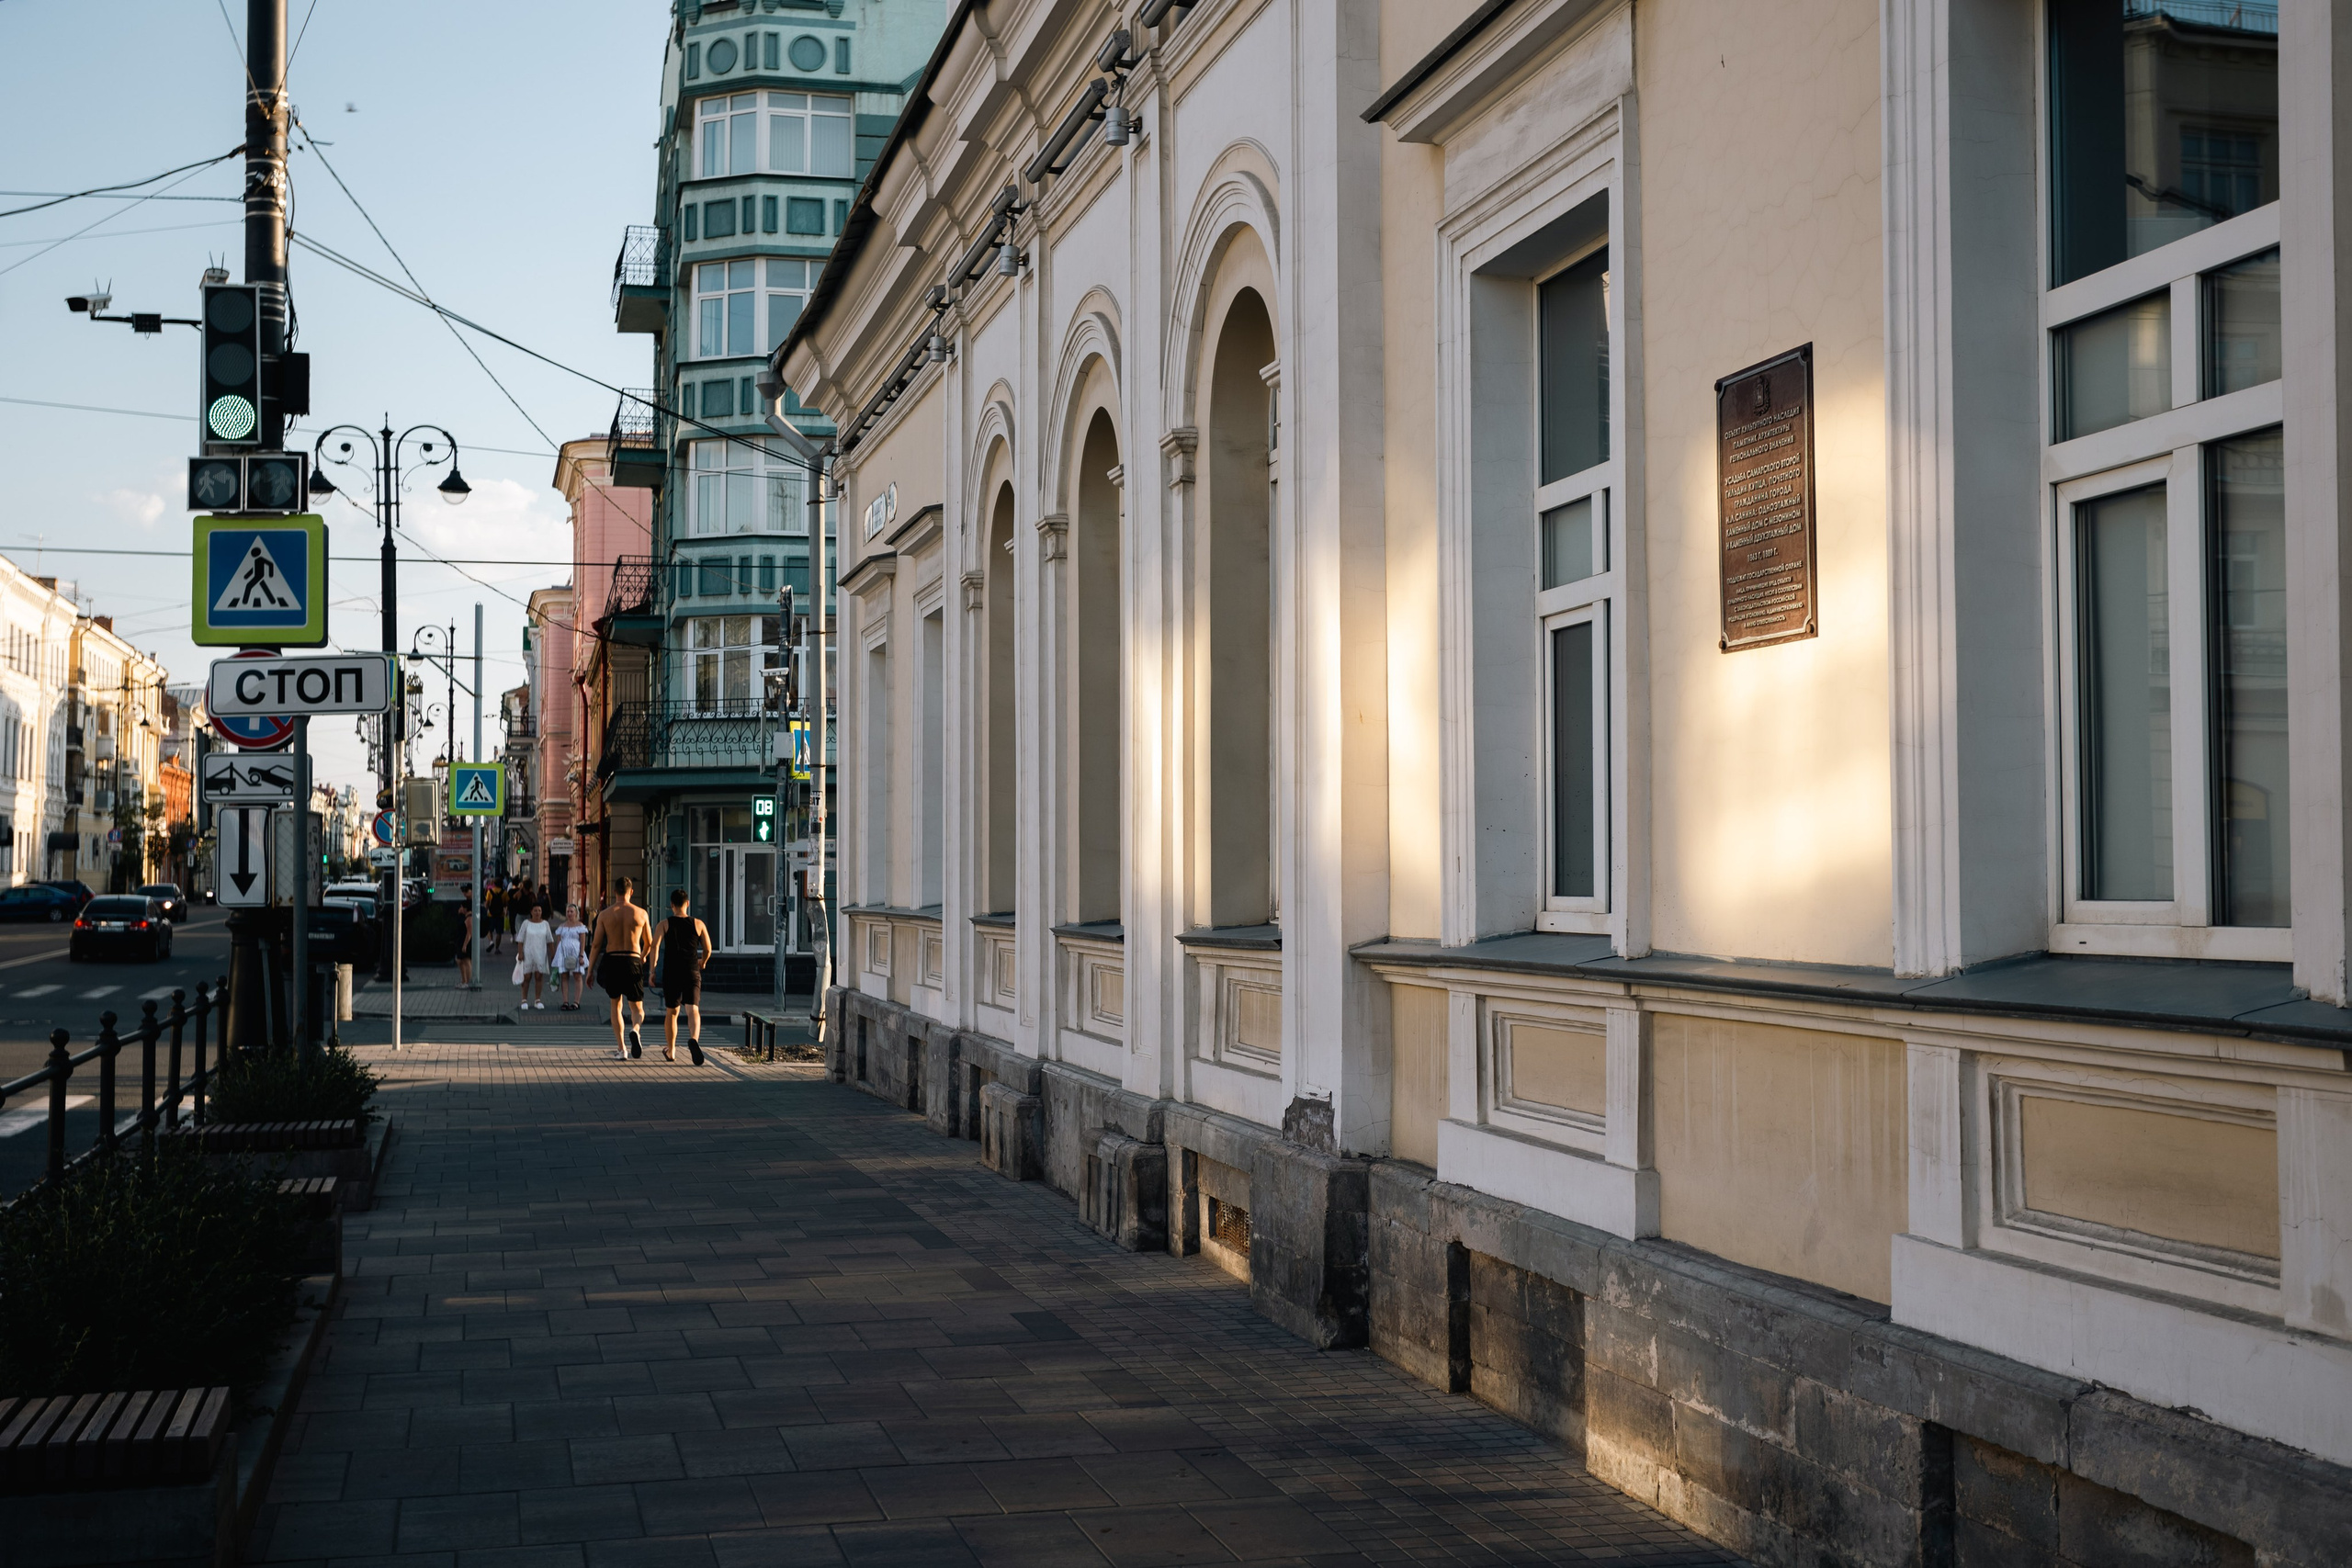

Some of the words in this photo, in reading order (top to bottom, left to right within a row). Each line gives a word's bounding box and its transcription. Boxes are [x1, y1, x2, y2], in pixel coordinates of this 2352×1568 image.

[1724, 426, 1741, 439] ОБЪЕКТ
[1741, 416, 1773, 434] КУЛЬТУРНОГО
[1773, 406, 1800, 422] НАСЛЕДИЯ
[1733, 434, 1758, 449] ПАМЯТНИК
[1758, 423, 1791, 440] АРХИТЕКТУРЫ
[1730, 444, 1769, 463] РЕГИОНАЛЬНОГО
[1770, 434, 1794, 450] ЗНАЧЕНИЯ
[1724, 472, 1746, 485] УСАДЬБА
[1747, 461, 1780, 478] САМАРСКОГО
[1781, 452, 1801, 468] ВТОРОЙ
[1725, 484, 1747, 499] ГИЛЬДИИ
[1748, 479, 1769, 491] КУПЦА,
[1770, 468, 1801, 485] ПОЧЕТНОГО
[1734, 491, 1769, 509] ГРАЖДАНИНА
[1770, 484, 1792, 498] ГОРОДА
[1758, 493, 1801, 514] ОДНОЭТАЖНЫЙ
[1726, 521, 1751, 537] КАМЕННЫЙ
[1751, 519, 1764, 531] ДОМ
[1764, 518, 1769, 526] С
[1769, 509, 1801, 525] МЕЗОНИНОМ
[1729, 534, 1754, 548] КАМЕННЫЙ
[1753, 525, 1789, 544] ДВУХЭТАЖНЫЙ
[1727, 573, 1747, 585] ПОДЛЕЖИТ
[1747, 563, 1784, 580] ГОСУДАРСТВЕННОЙ
[1784, 560, 1803, 570] ОХРАНЕ
[235, 668, 364, 705] СТОП
[756, 799, 774, 816] 08
